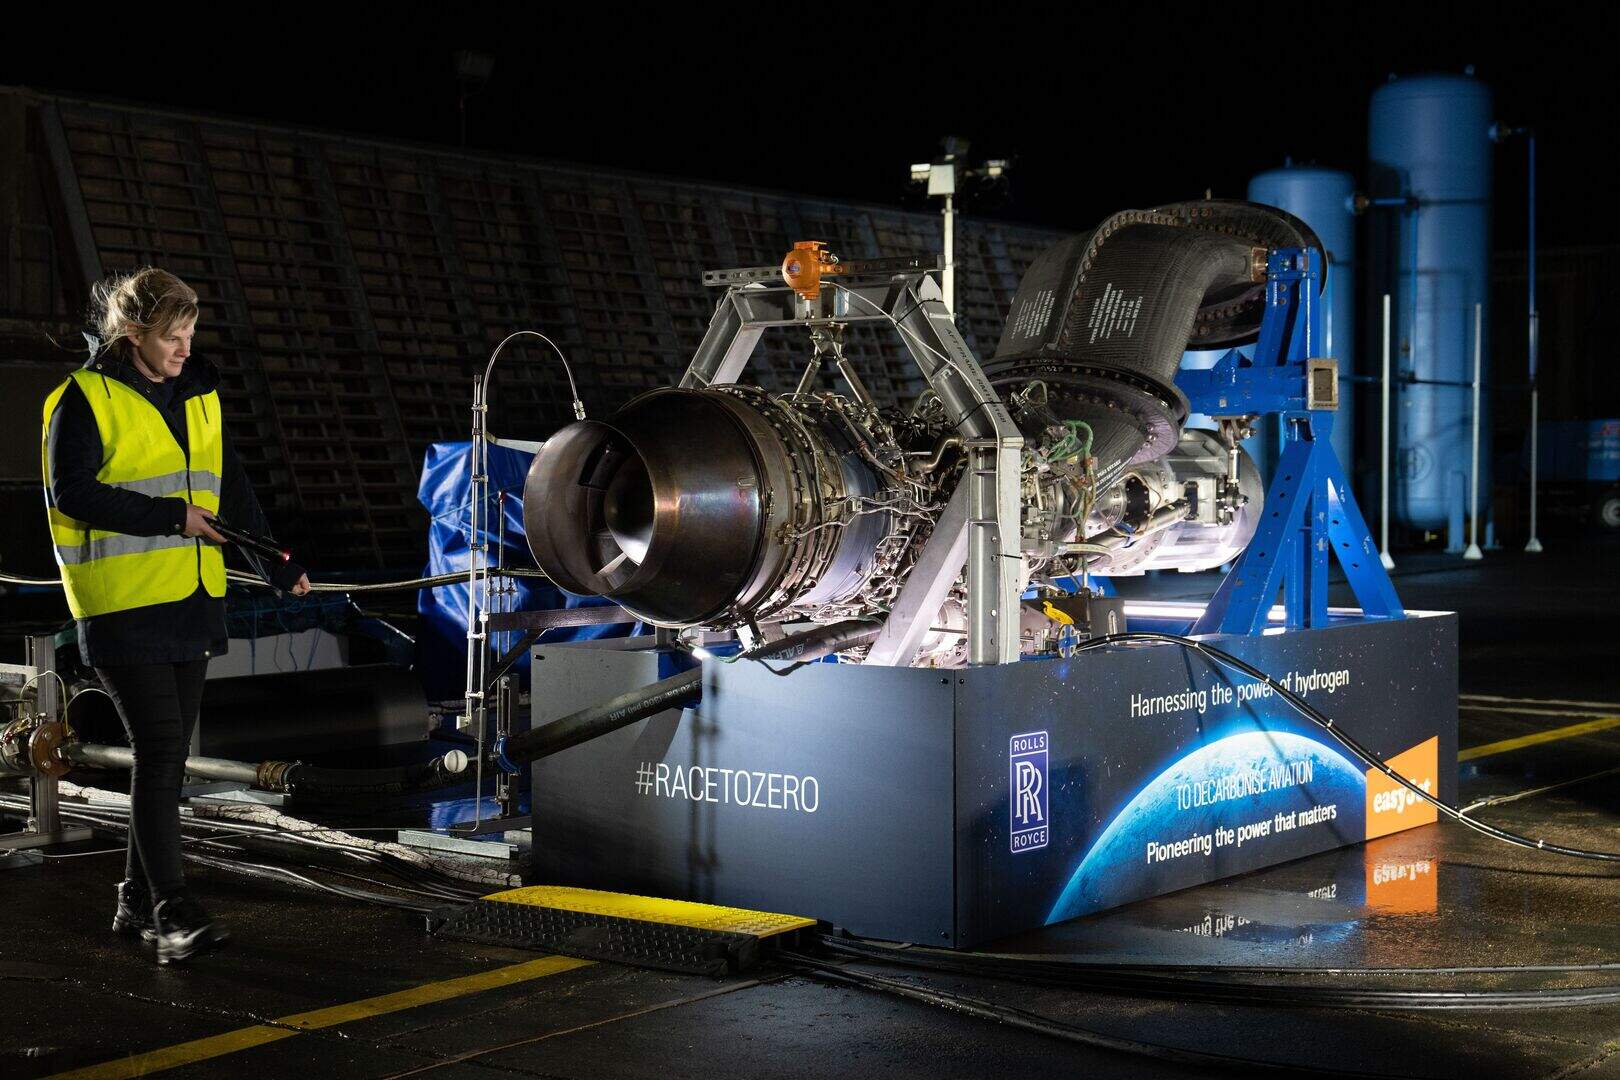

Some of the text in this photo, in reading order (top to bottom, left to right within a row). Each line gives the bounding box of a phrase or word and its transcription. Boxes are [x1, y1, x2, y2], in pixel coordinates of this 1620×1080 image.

[1131, 688, 1207, 718] Harnessing
[1211, 682, 1233, 706] the
[1237, 674, 1274, 708] power
[1294, 669, 1350, 698] hydrogen
[1014, 736, 1045, 752] ROLLS
[635, 762, 819, 813] #RACETOZERO
[1177, 760, 1313, 811] TO DECARBONISE AVIATION
[1014, 830, 1046, 848] ROYCE
[1147, 803, 1337, 864] Pioneering the power that matters
